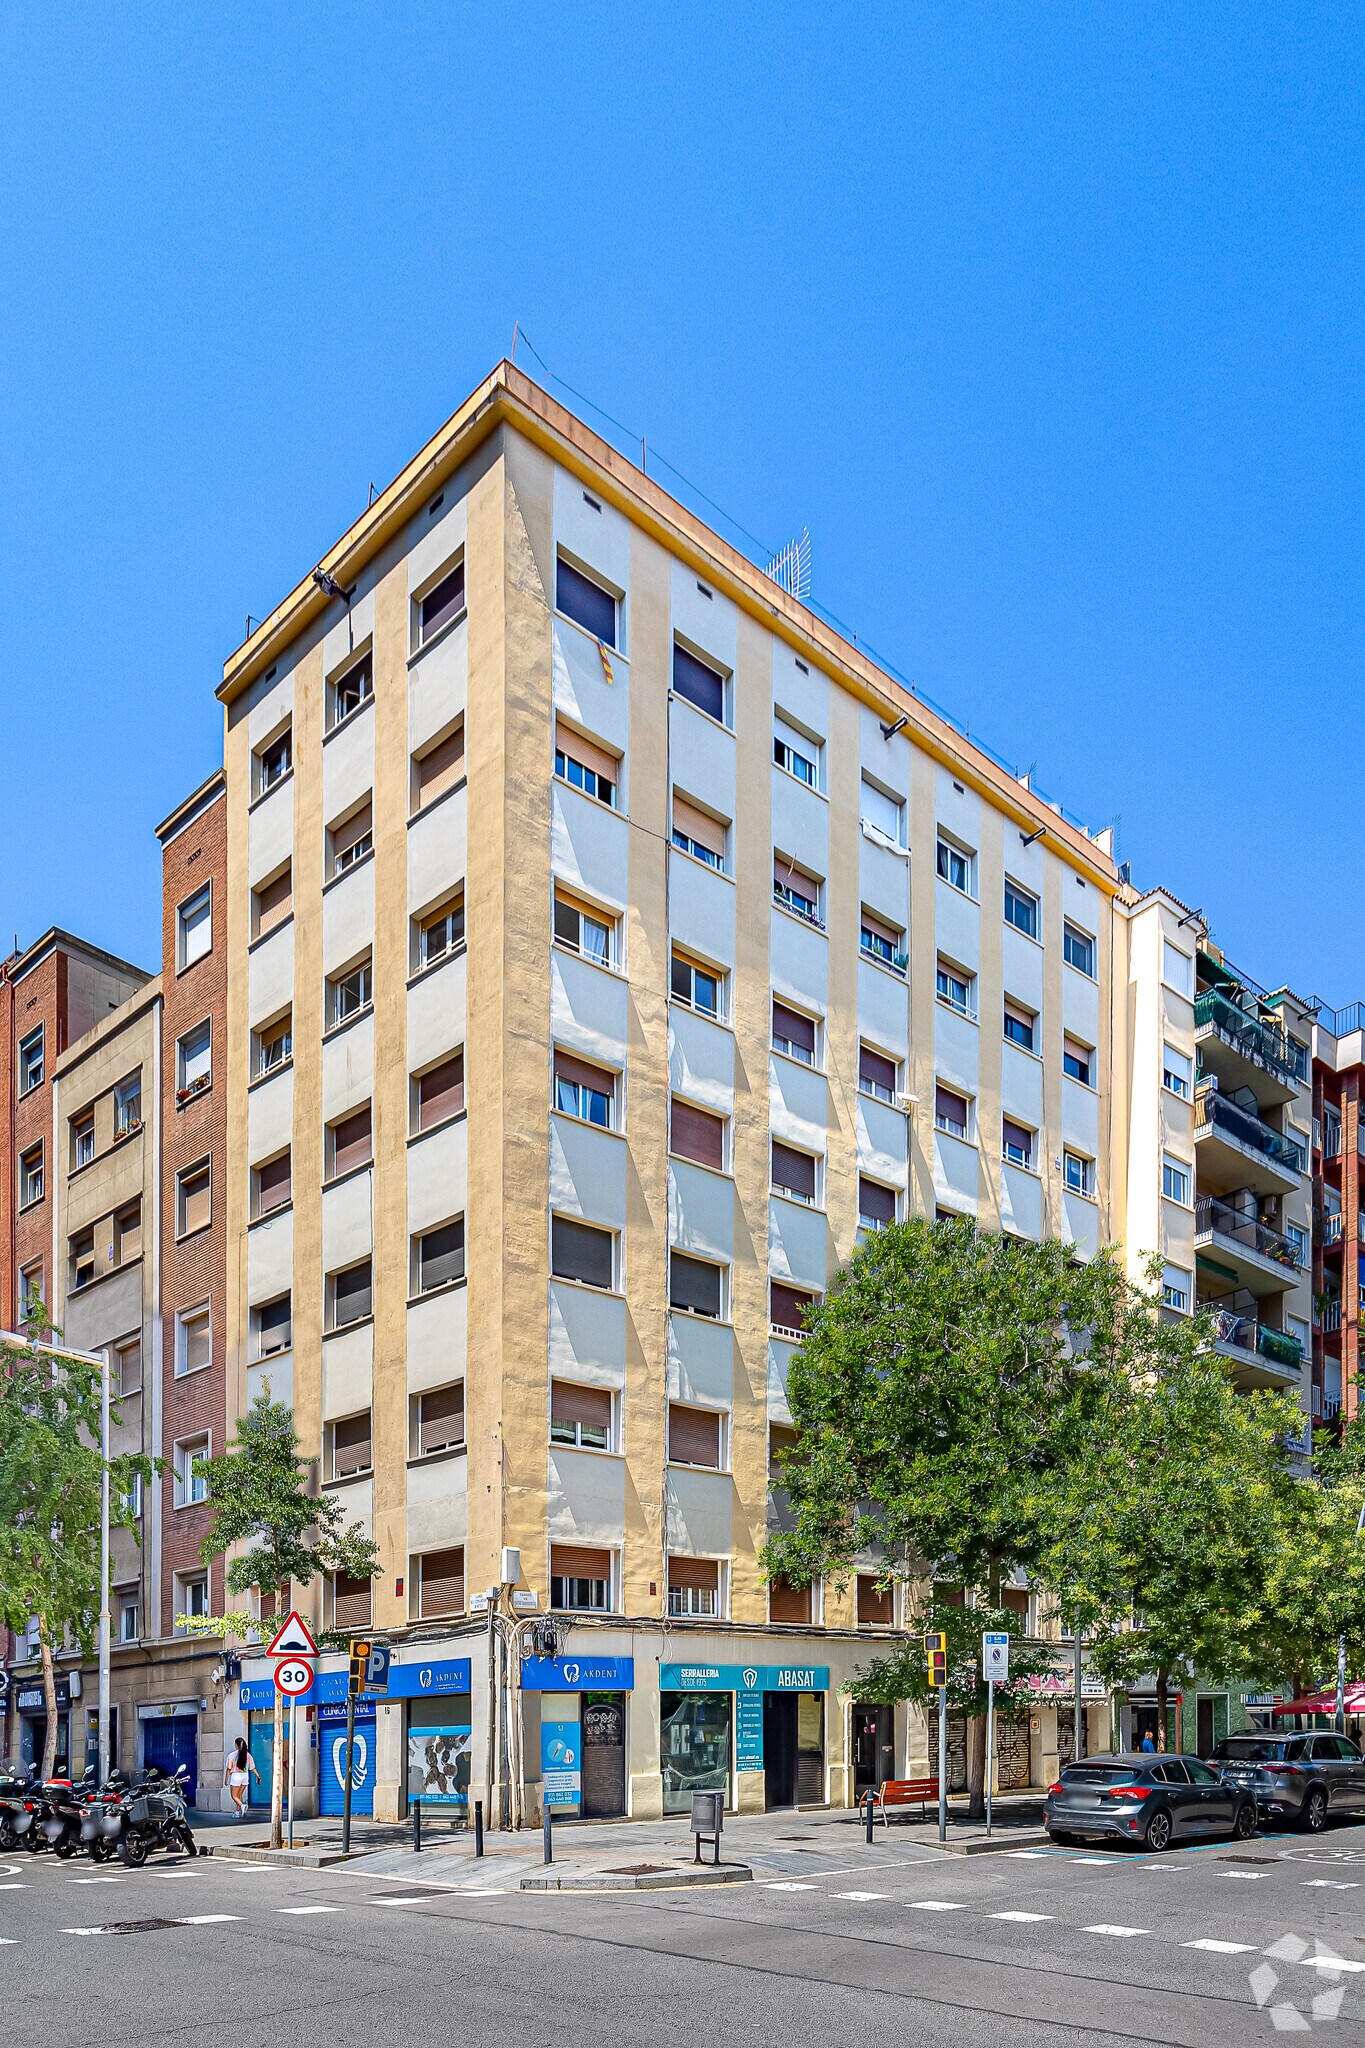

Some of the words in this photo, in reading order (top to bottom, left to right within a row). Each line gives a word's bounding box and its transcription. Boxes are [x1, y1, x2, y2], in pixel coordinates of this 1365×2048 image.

[367, 1651, 385, 1681] P
[282, 1670, 306, 1683] 30
[582, 1669, 617, 1678] AKDENT
[680, 1668, 719, 1678] SERRALLERIA
[778, 1670, 816, 1687] ABASAT
[681, 1678, 696, 1686] DESDE
